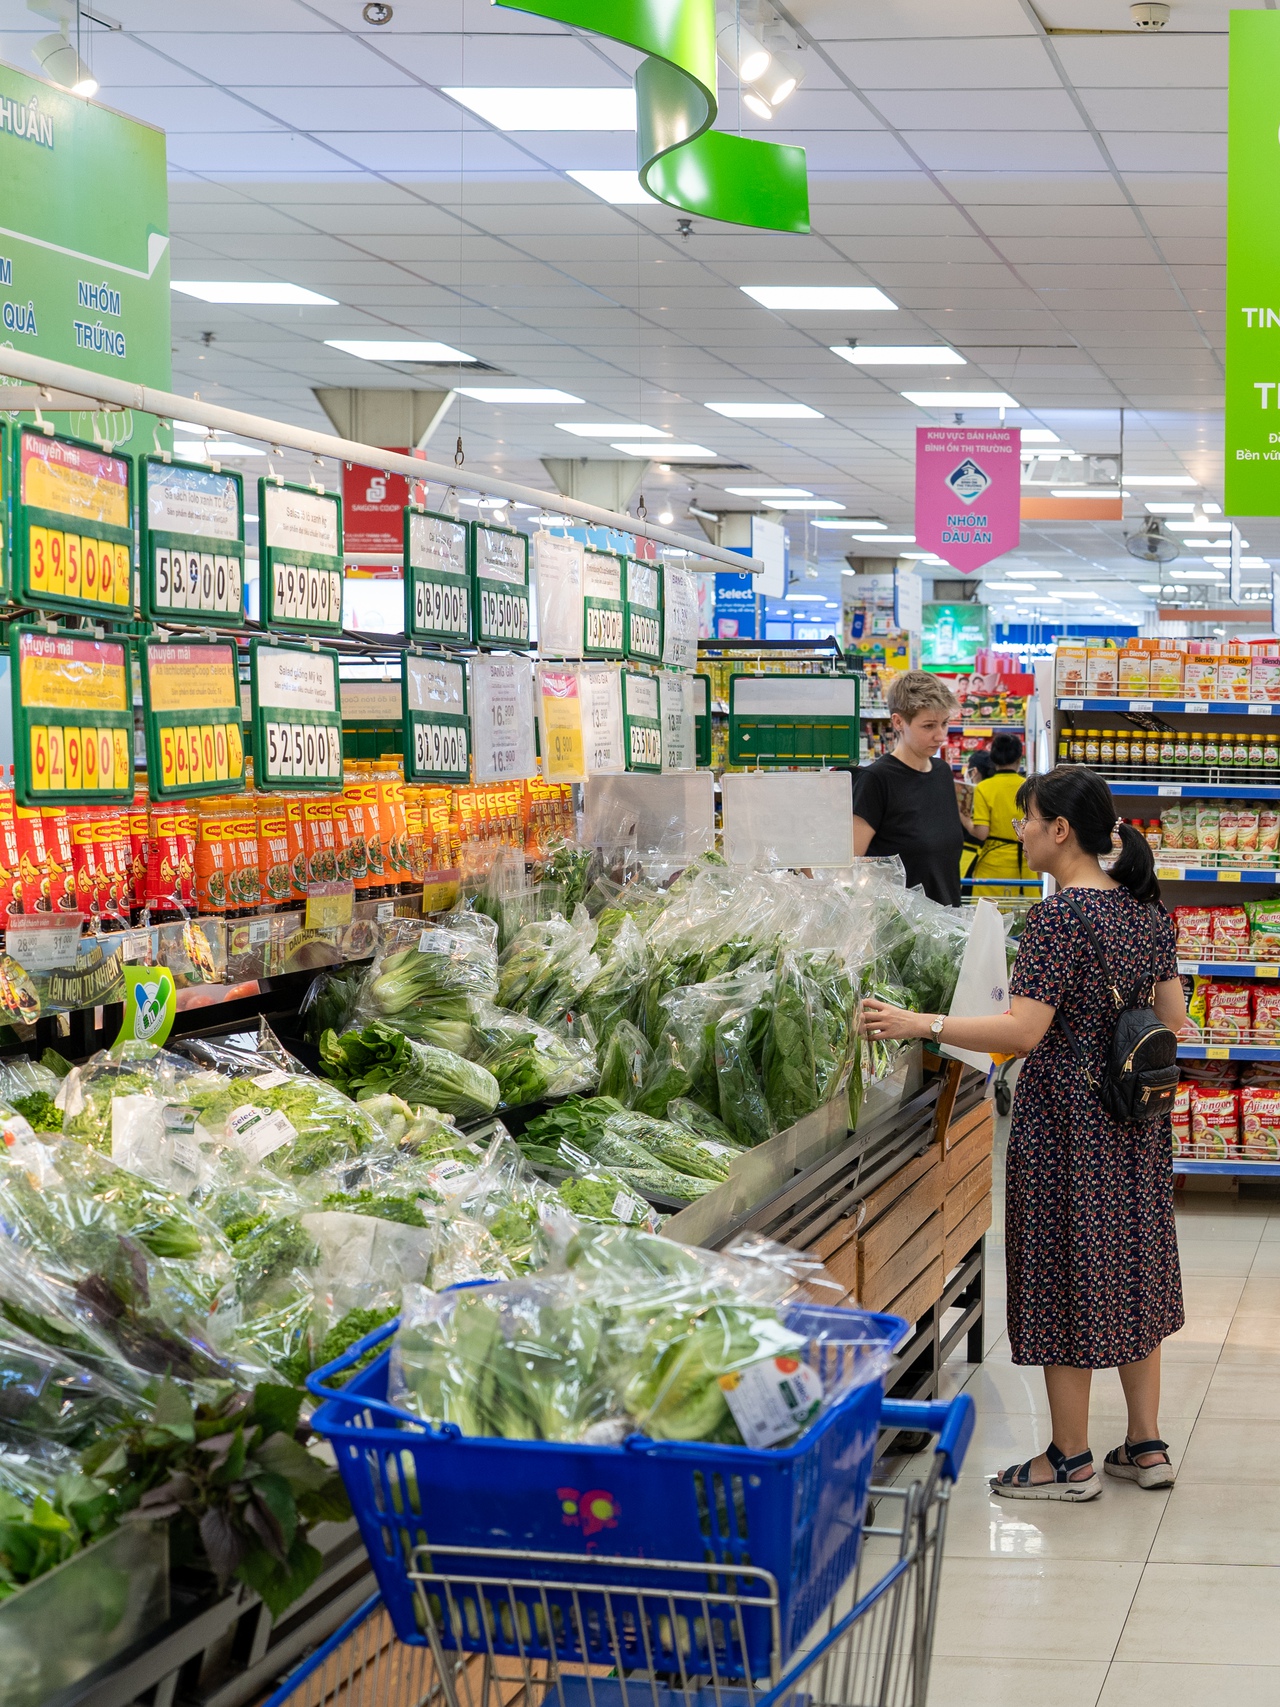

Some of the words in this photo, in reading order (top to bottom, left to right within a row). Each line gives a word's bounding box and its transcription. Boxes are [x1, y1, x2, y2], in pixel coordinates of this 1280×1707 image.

[77, 280, 121, 316] NHÓM
[3, 300, 38, 336] QUẢ
[73, 321, 126, 358] TRỨNG
[925, 442, 945, 452] BÌNH
[927, 432, 944, 440] KHU
[946, 432, 965, 441] VỰC
[966, 430, 984, 440] BÁN
[986, 431, 1010, 441] HÀNG
[1236, 449, 1260, 461] Bền
[942, 527, 969, 544] DẦU
[972, 529, 992, 544] ĂN
[947, 512, 987, 527] NHÓM
[34, 537, 112, 592] 39.500
[160, 557, 225, 600] 53.900
[277, 570, 327, 610] 49.900
[416, 587, 458, 622] 68.900
[718, 588, 754, 599] Select
[36, 734, 110, 777] 62.900
[165, 731, 224, 773] 56.500
[269, 729, 325, 766] 52.500
